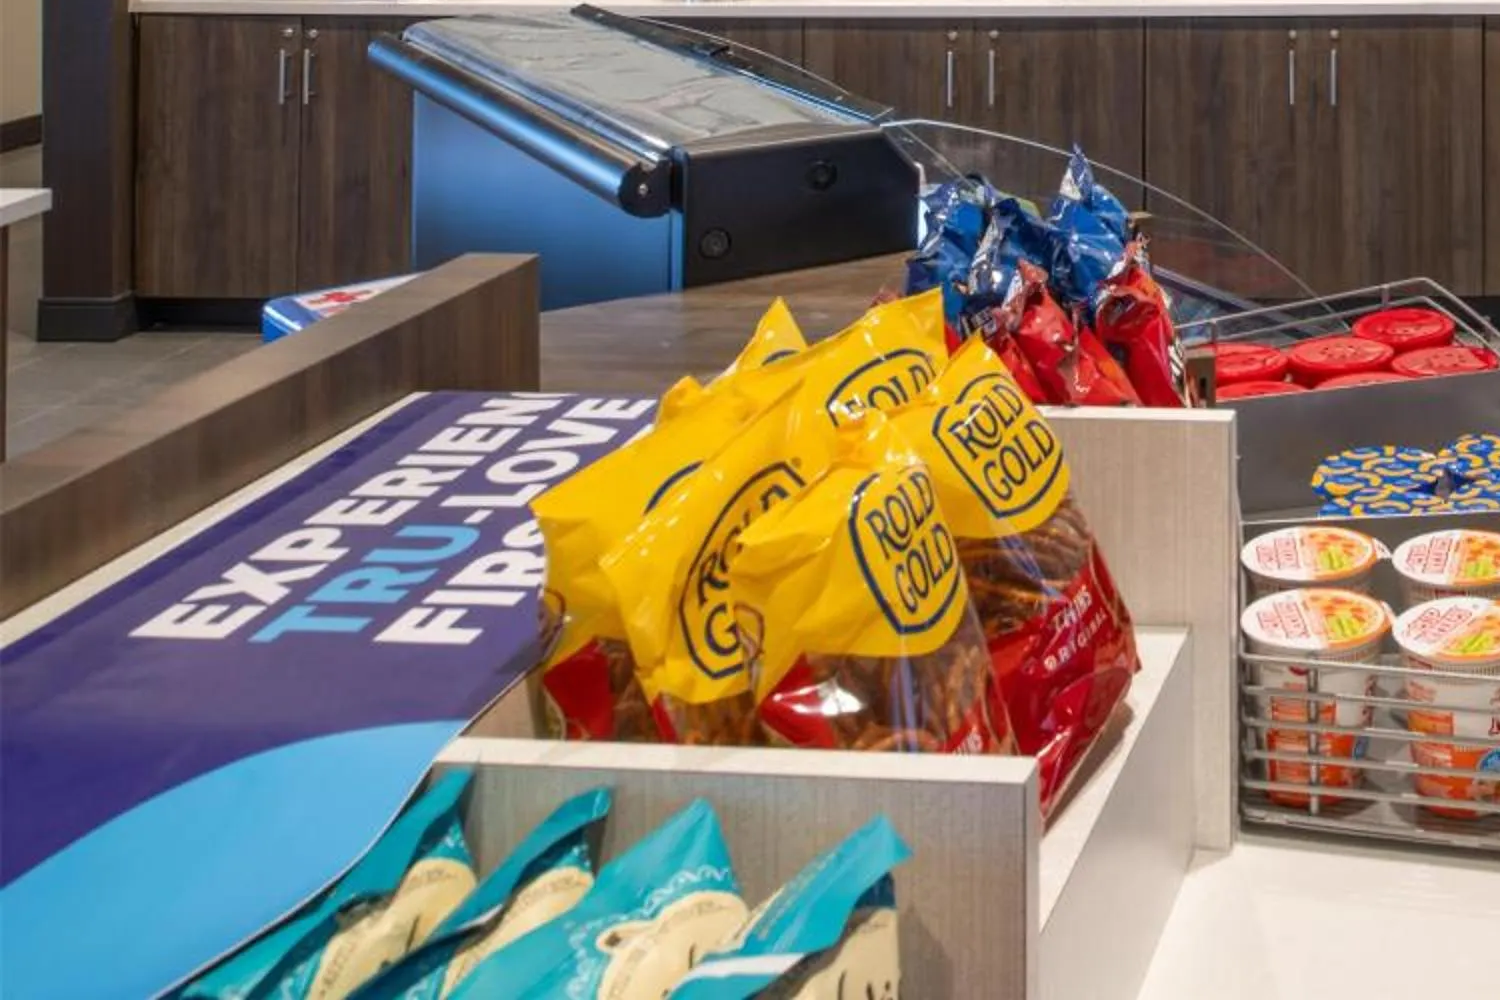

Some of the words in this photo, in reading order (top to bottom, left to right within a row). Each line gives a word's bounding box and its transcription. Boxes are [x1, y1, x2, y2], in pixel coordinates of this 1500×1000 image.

[949, 384, 1024, 459] ROLD
[983, 420, 1055, 501] GOLD
[128, 392, 581, 639] EXPERIEN
[247, 398, 657, 642] TRU-LOVE
[864, 471, 935, 560] ROLD
[895, 522, 953, 614] GOLD
